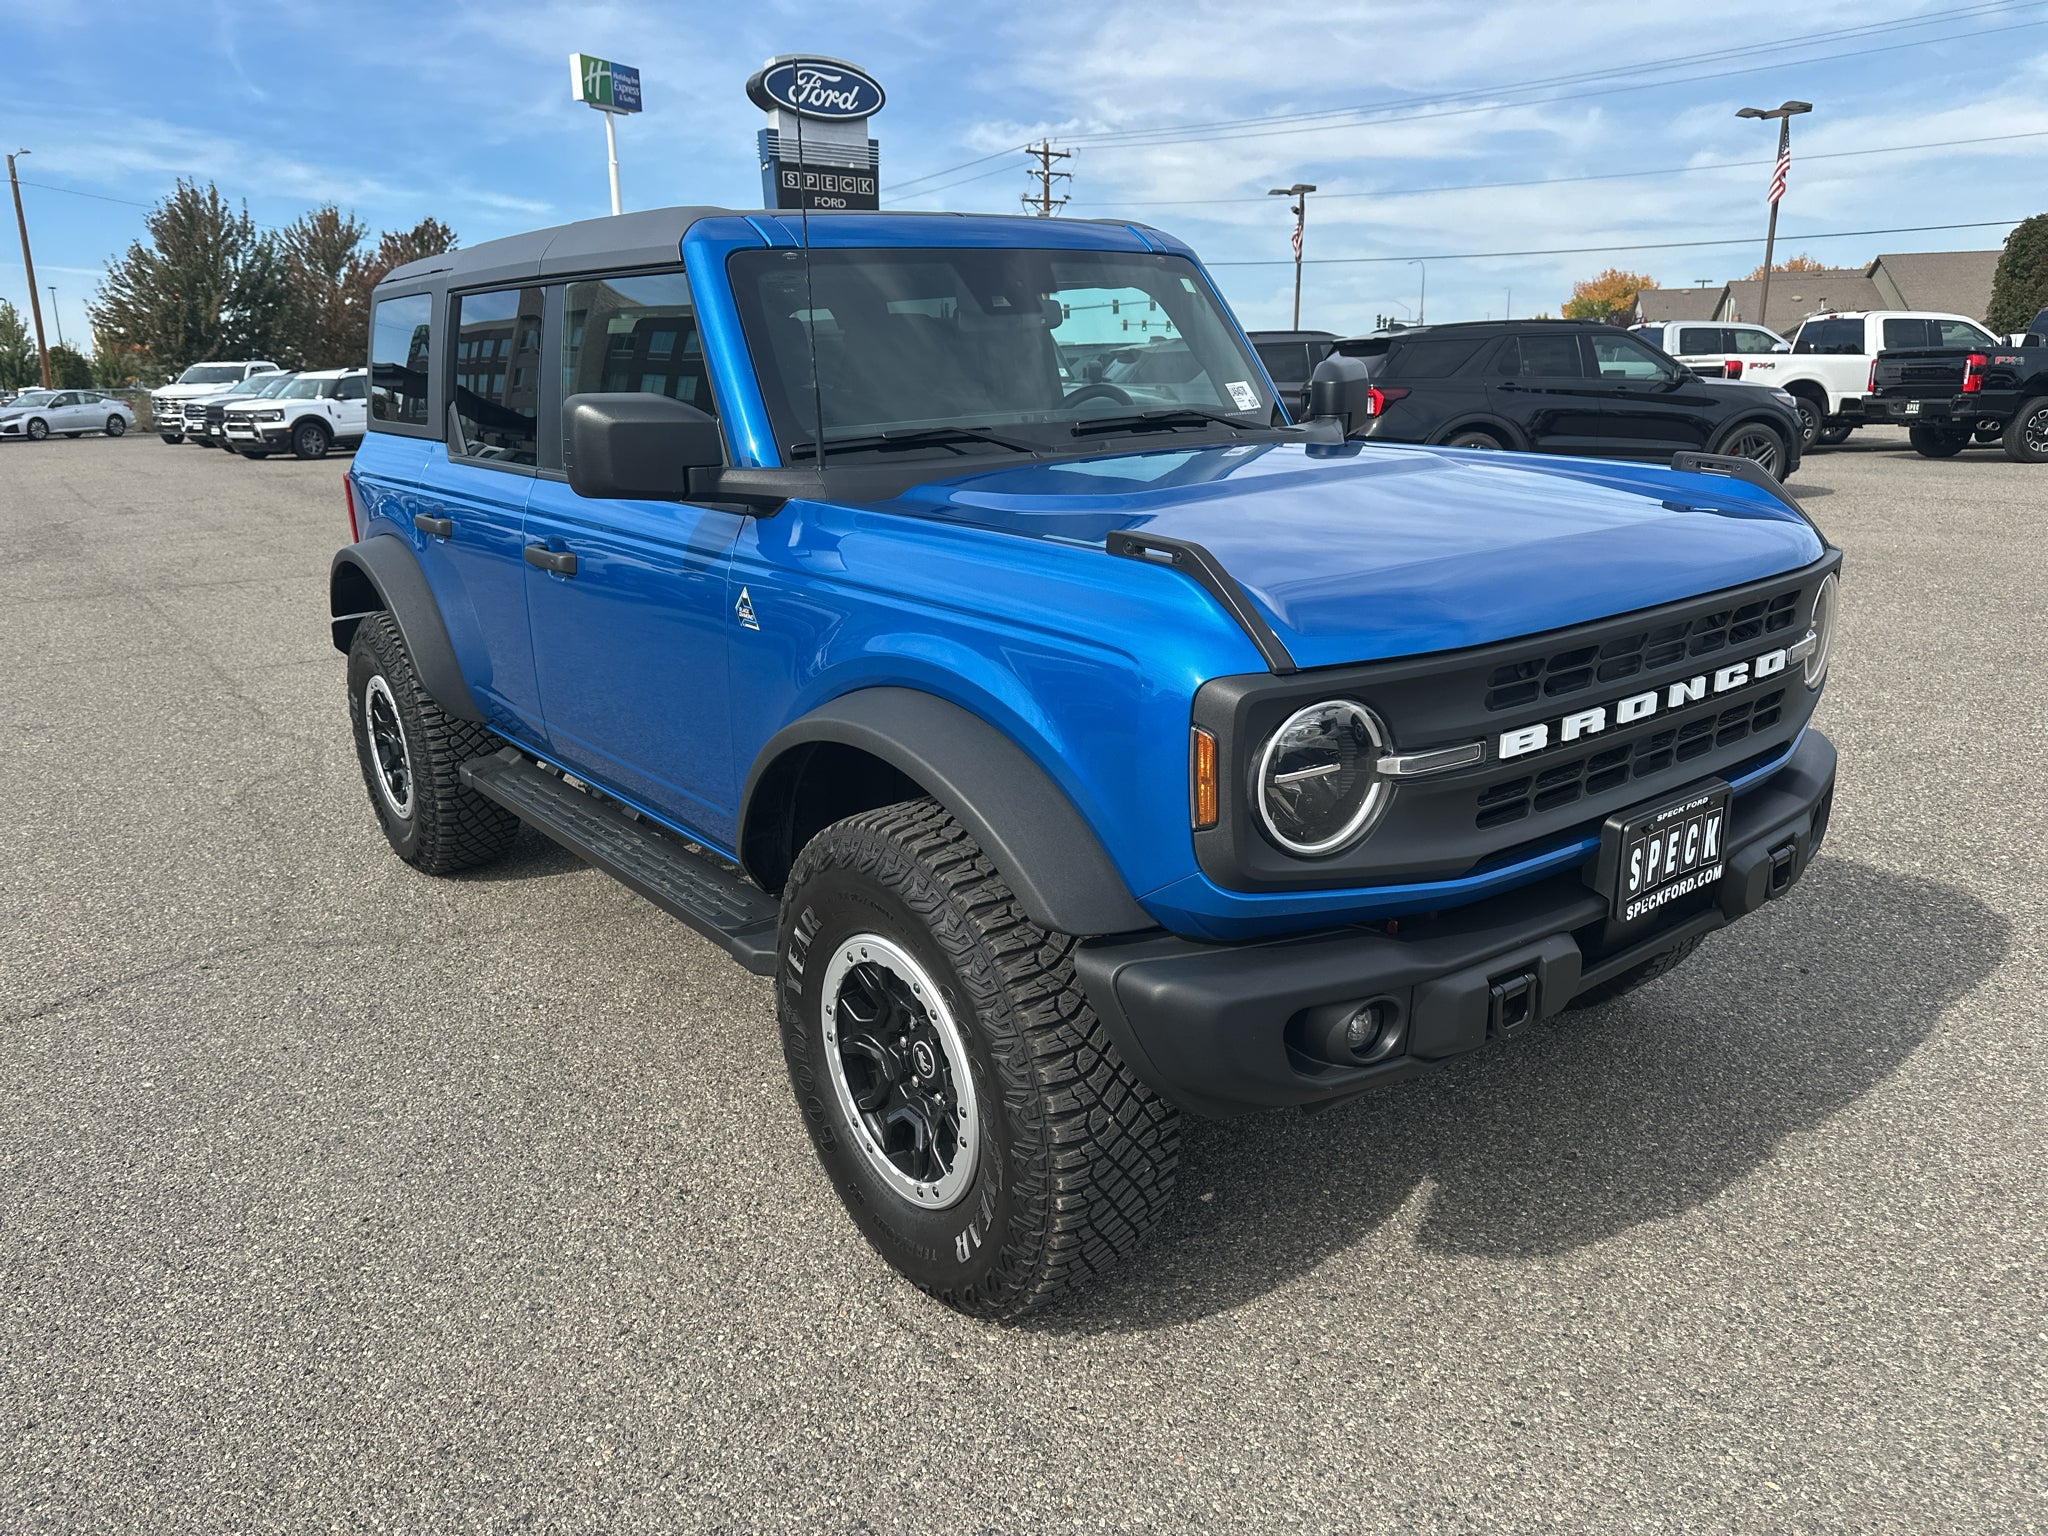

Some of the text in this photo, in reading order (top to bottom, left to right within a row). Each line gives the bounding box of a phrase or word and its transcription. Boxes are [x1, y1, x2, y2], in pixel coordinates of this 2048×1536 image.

[613, 80, 640, 96] Express
[788, 69, 860, 111] Ford
[785, 172, 872, 193] SPECK
[814, 196, 847, 209] FORD
[1748, 362, 1776, 370] FX4
[1994, 355, 2025, 366] FX4
[1499, 648, 1788, 759] BRONCO
[1656, 796, 1709, 822] SPECK FORD
[1629, 816, 1720, 891] SPECK
[1626, 865, 1723, 921] SPECKFORD.COM
